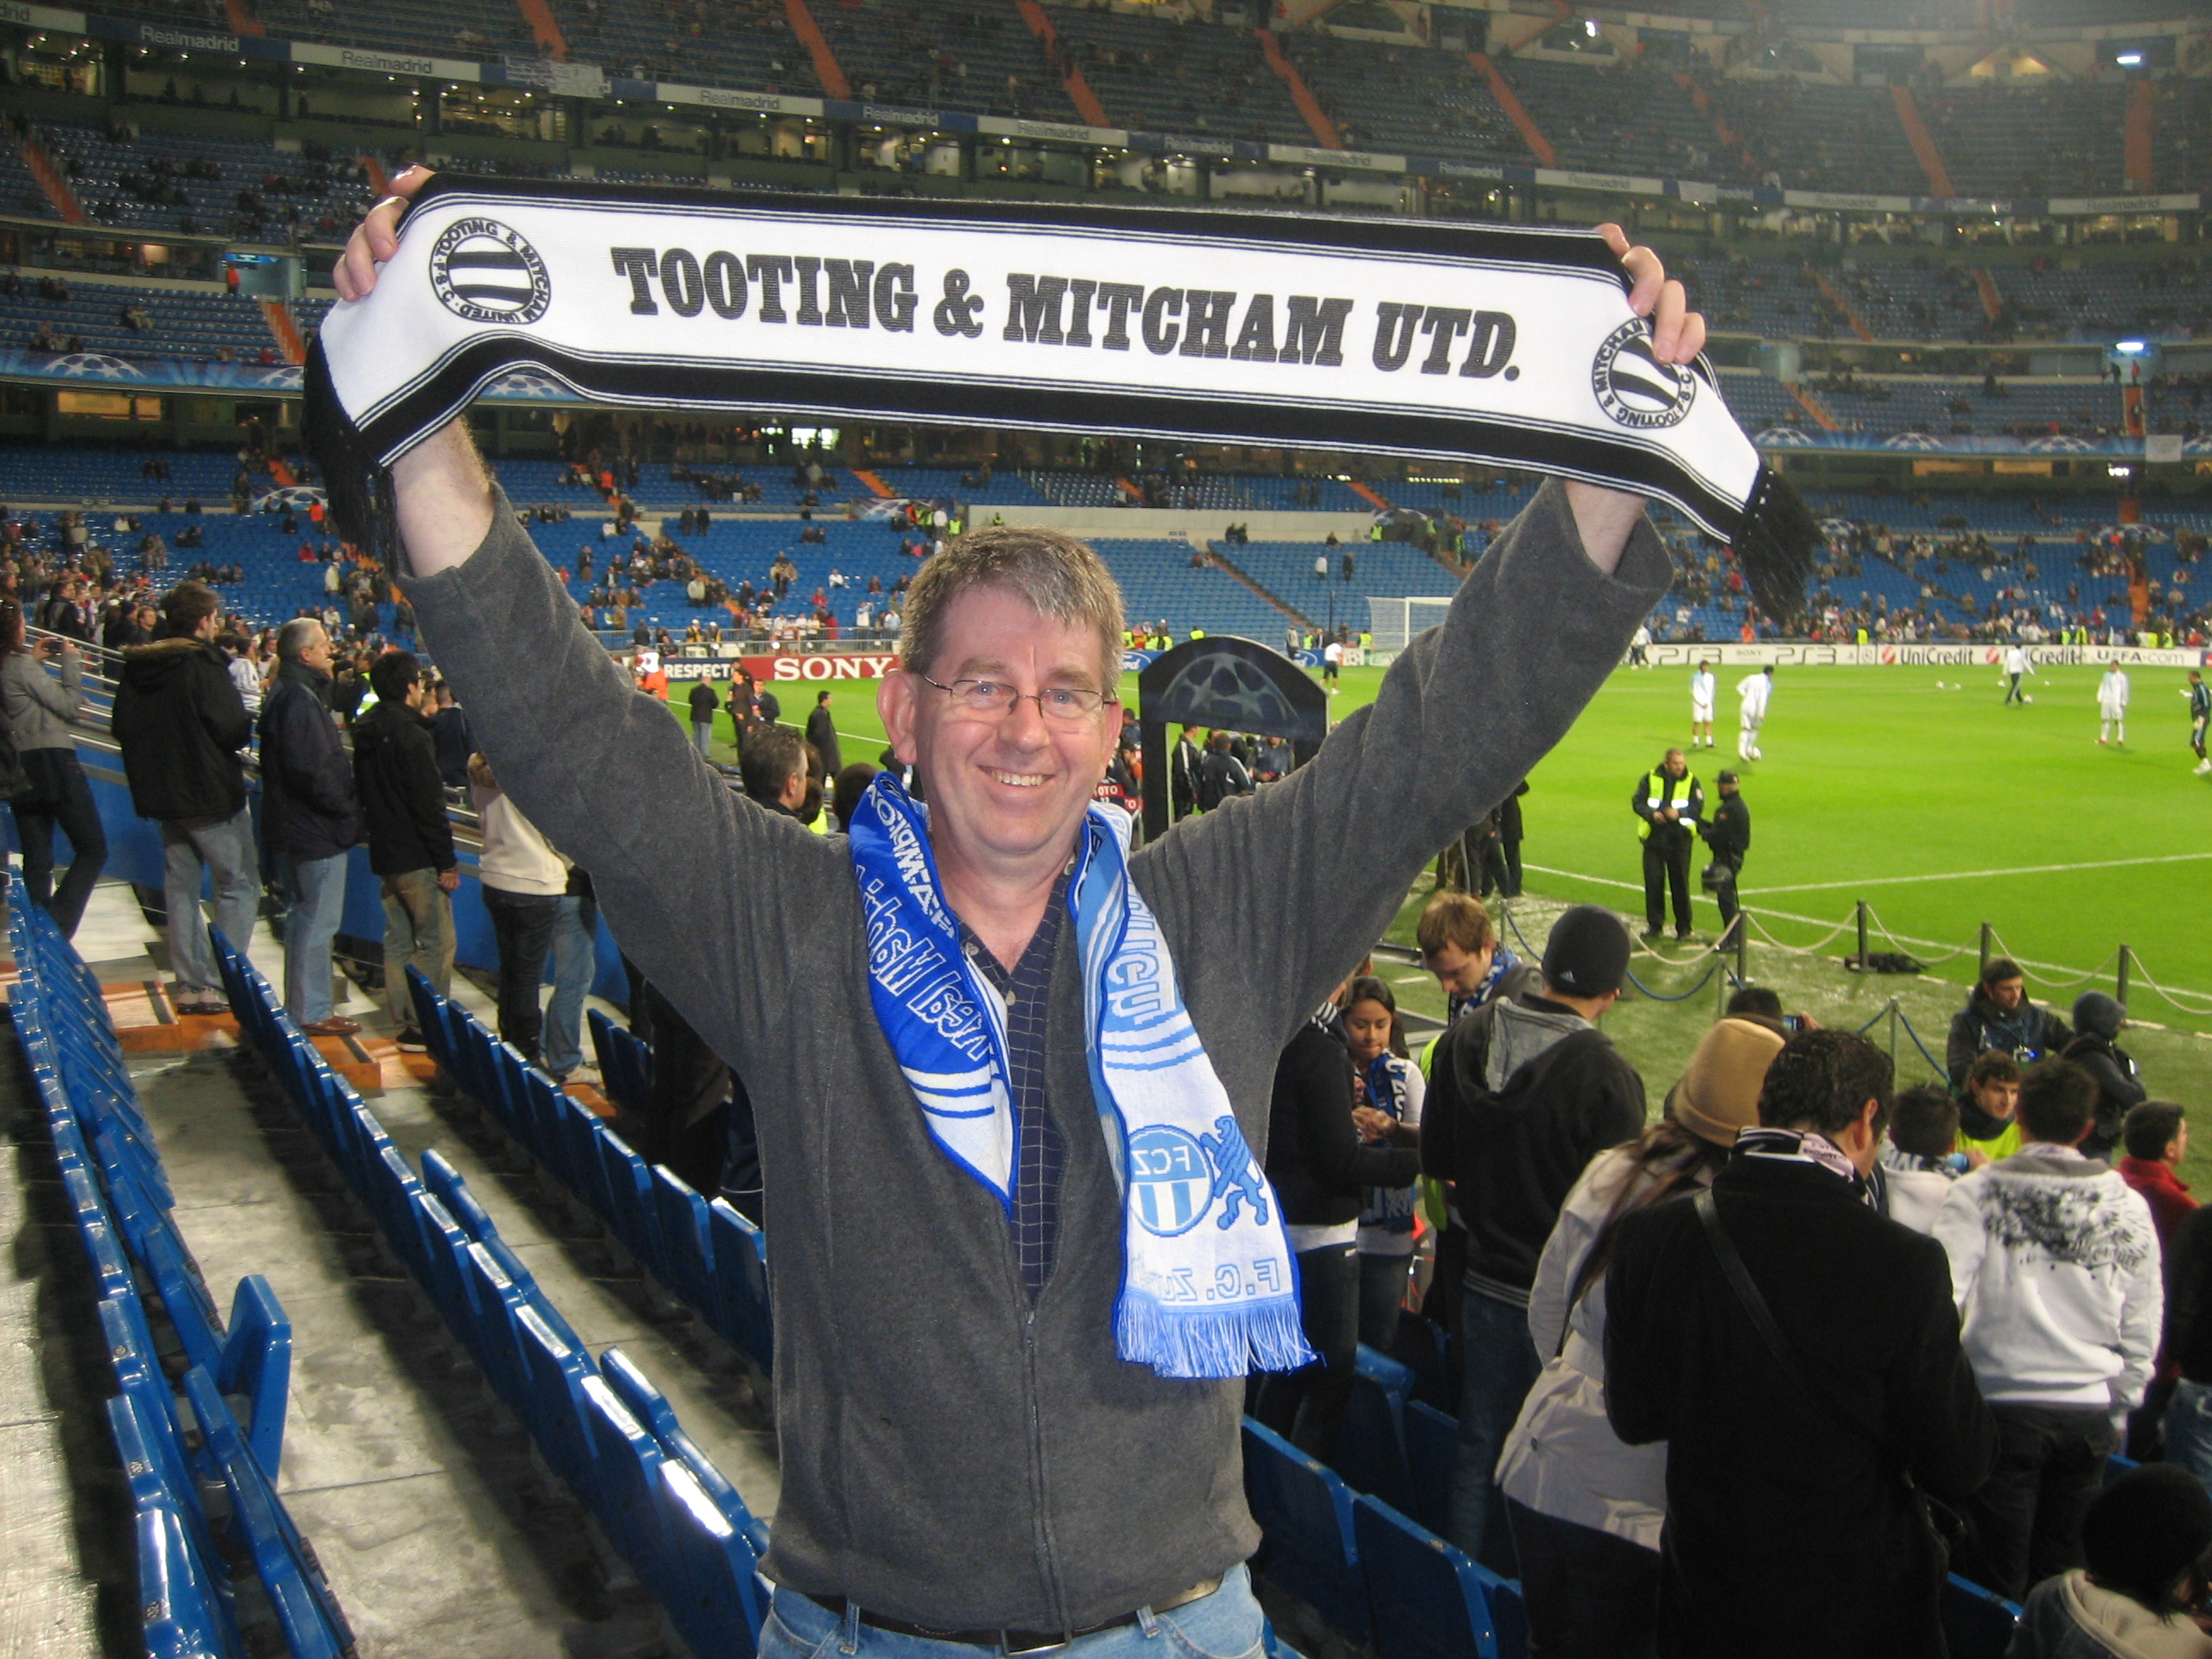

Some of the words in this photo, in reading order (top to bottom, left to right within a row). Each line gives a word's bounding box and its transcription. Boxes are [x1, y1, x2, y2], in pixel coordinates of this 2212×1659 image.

[342, 51, 432, 74] Realmadrid
[701, 90, 779, 111] Realmadrid
[434, 219, 498, 257] TOOTING
[519, 245, 550, 321] MITCHAM
[609, 246, 919, 333] TOOTING
[934, 268, 985, 338] &
[1003, 272, 1355, 367] MITCHAM
[1371, 301, 1521, 382] UTD.
[1615, 406, 1680, 427] TOOTING
[1659, 647, 1722, 665] PS3
[1776, 647, 1837, 665] PS3
[1901, 646, 1974, 666] UniCredit
[663, 662, 731, 679] RESPECT
[773, 656, 894, 681] SONY
